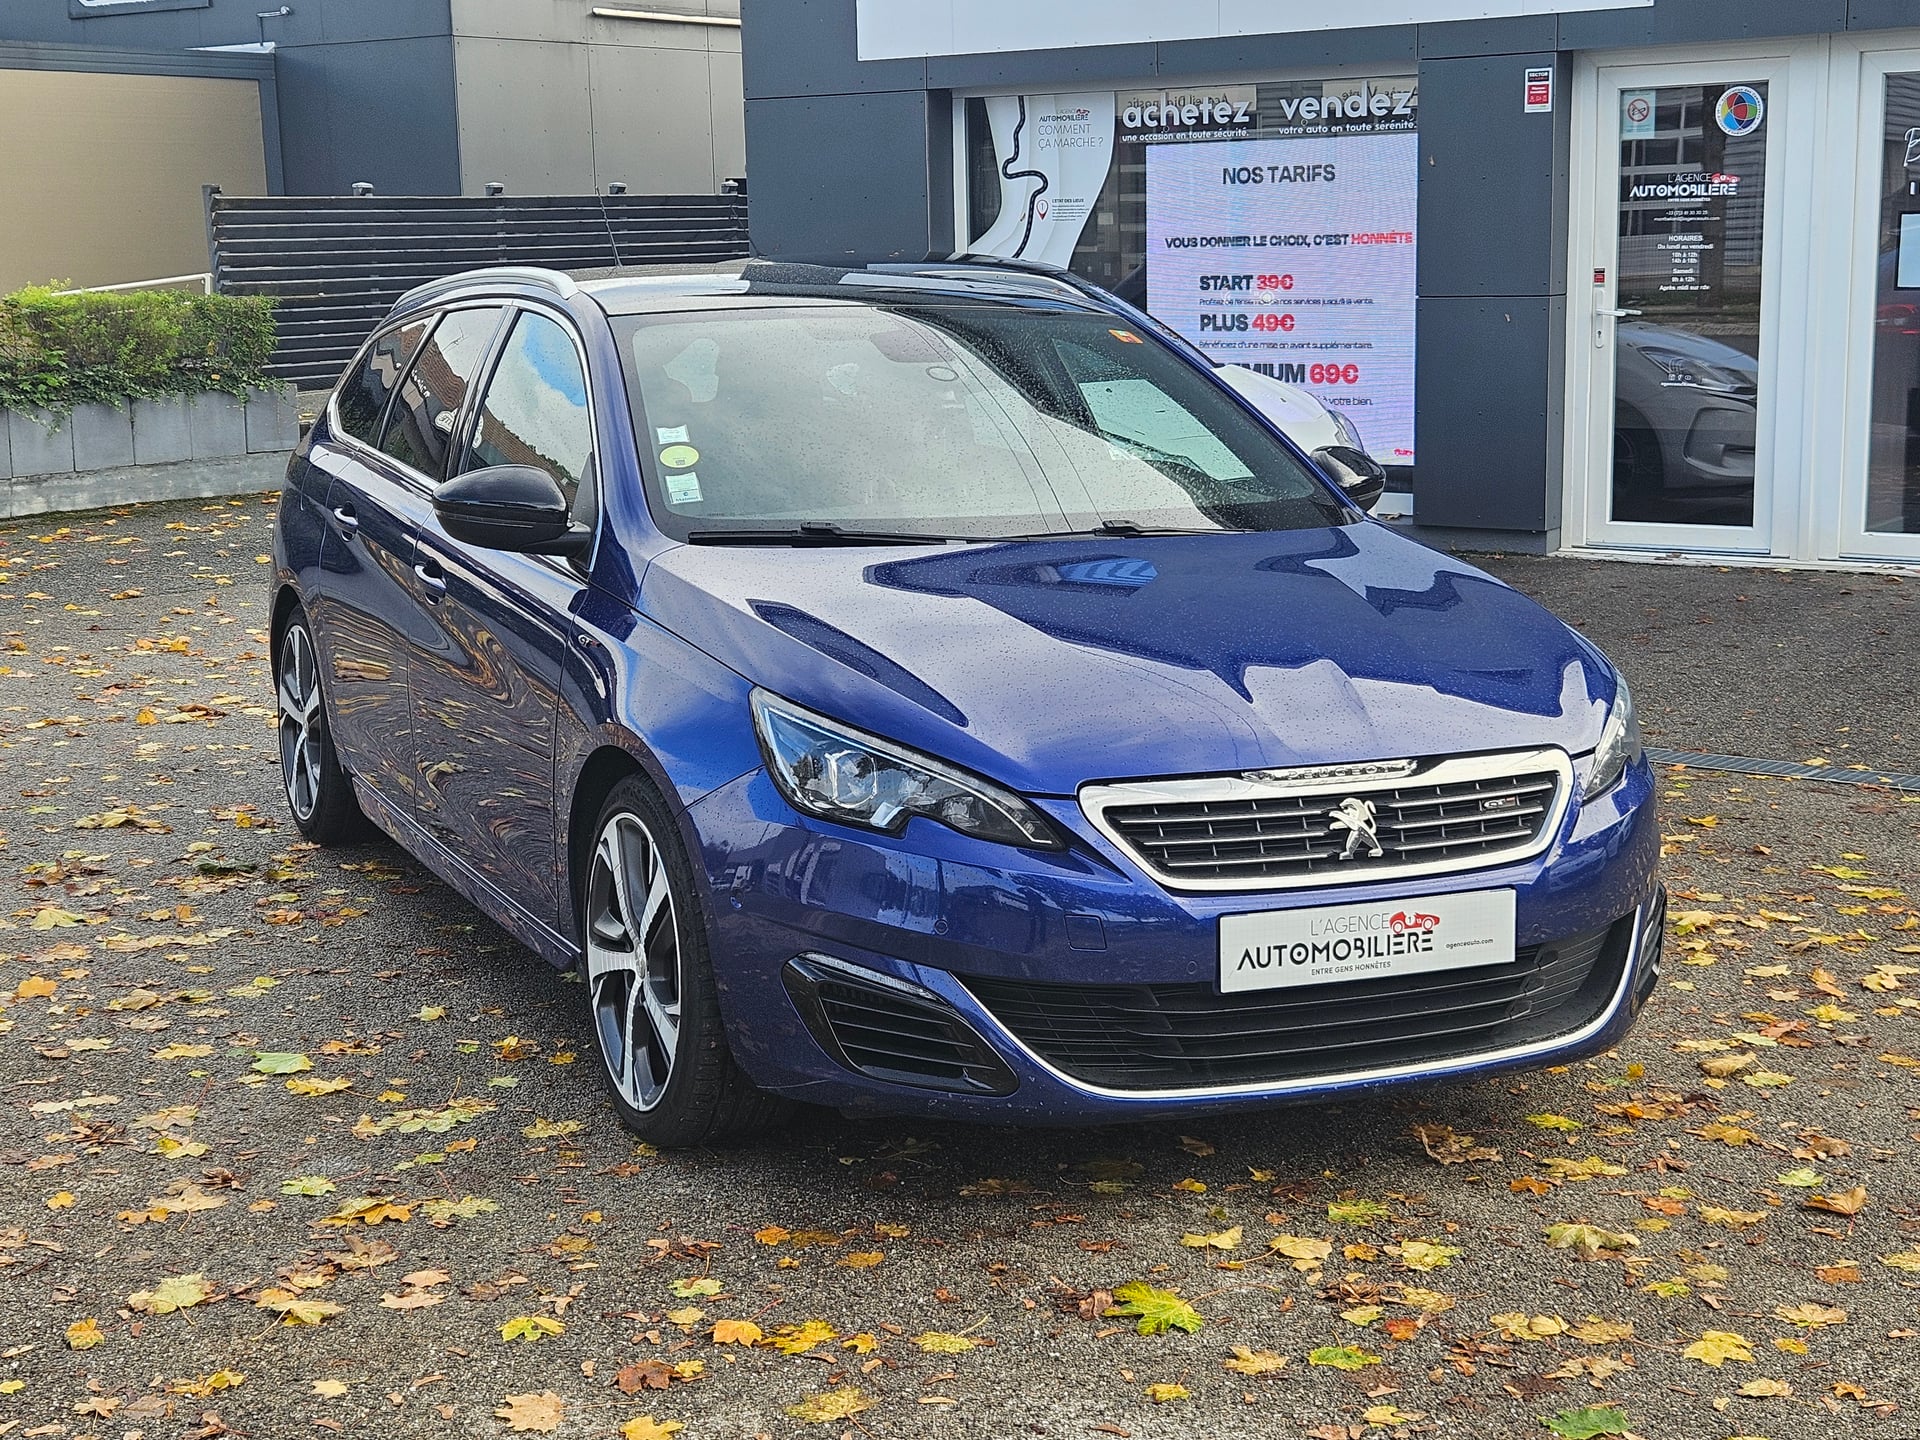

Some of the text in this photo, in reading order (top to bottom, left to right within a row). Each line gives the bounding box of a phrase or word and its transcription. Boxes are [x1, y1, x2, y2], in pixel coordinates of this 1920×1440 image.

[1279, 80, 1413, 121] vendez
[1122, 91, 1250, 128] achetez
[1038, 124, 1091, 135] COMMENT
[1139, 131, 1173, 141] occasion
[1189, 131, 1211, 139] toute
[1214, 127, 1249, 138] sécurité.
[1278, 126, 1303, 135] votre
[1306, 124, 1328, 133] auto
[1346, 122, 1372, 131] toute
[1375, 119, 1417, 131] sérénité.
[1038, 136, 1104, 151] ÇA MARCHE ?
[1222, 164, 1336, 185] NOS TARIFS
[1668, 173, 1712, 182] L'AGENCE
[1165, 230, 1413, 248] VOUS DONNER LE CHOIX, C'EST HONNÊTE
[1199, 274, 1294, 290] START 39€
[1199, 313, 1295, 331] PLUS 49€
[1309, 363, 1360, 384] 69€
[1328, 397, 1351, 405] votre
[1352, 396, 1374, 405] bien.
[1287, 763, 1394, 781] PEUGEOT
[1311, 912, 1390, 936] L'AGENCE
[1311, 961, 1392, 976] ENTRE GENS HONNÊTES
